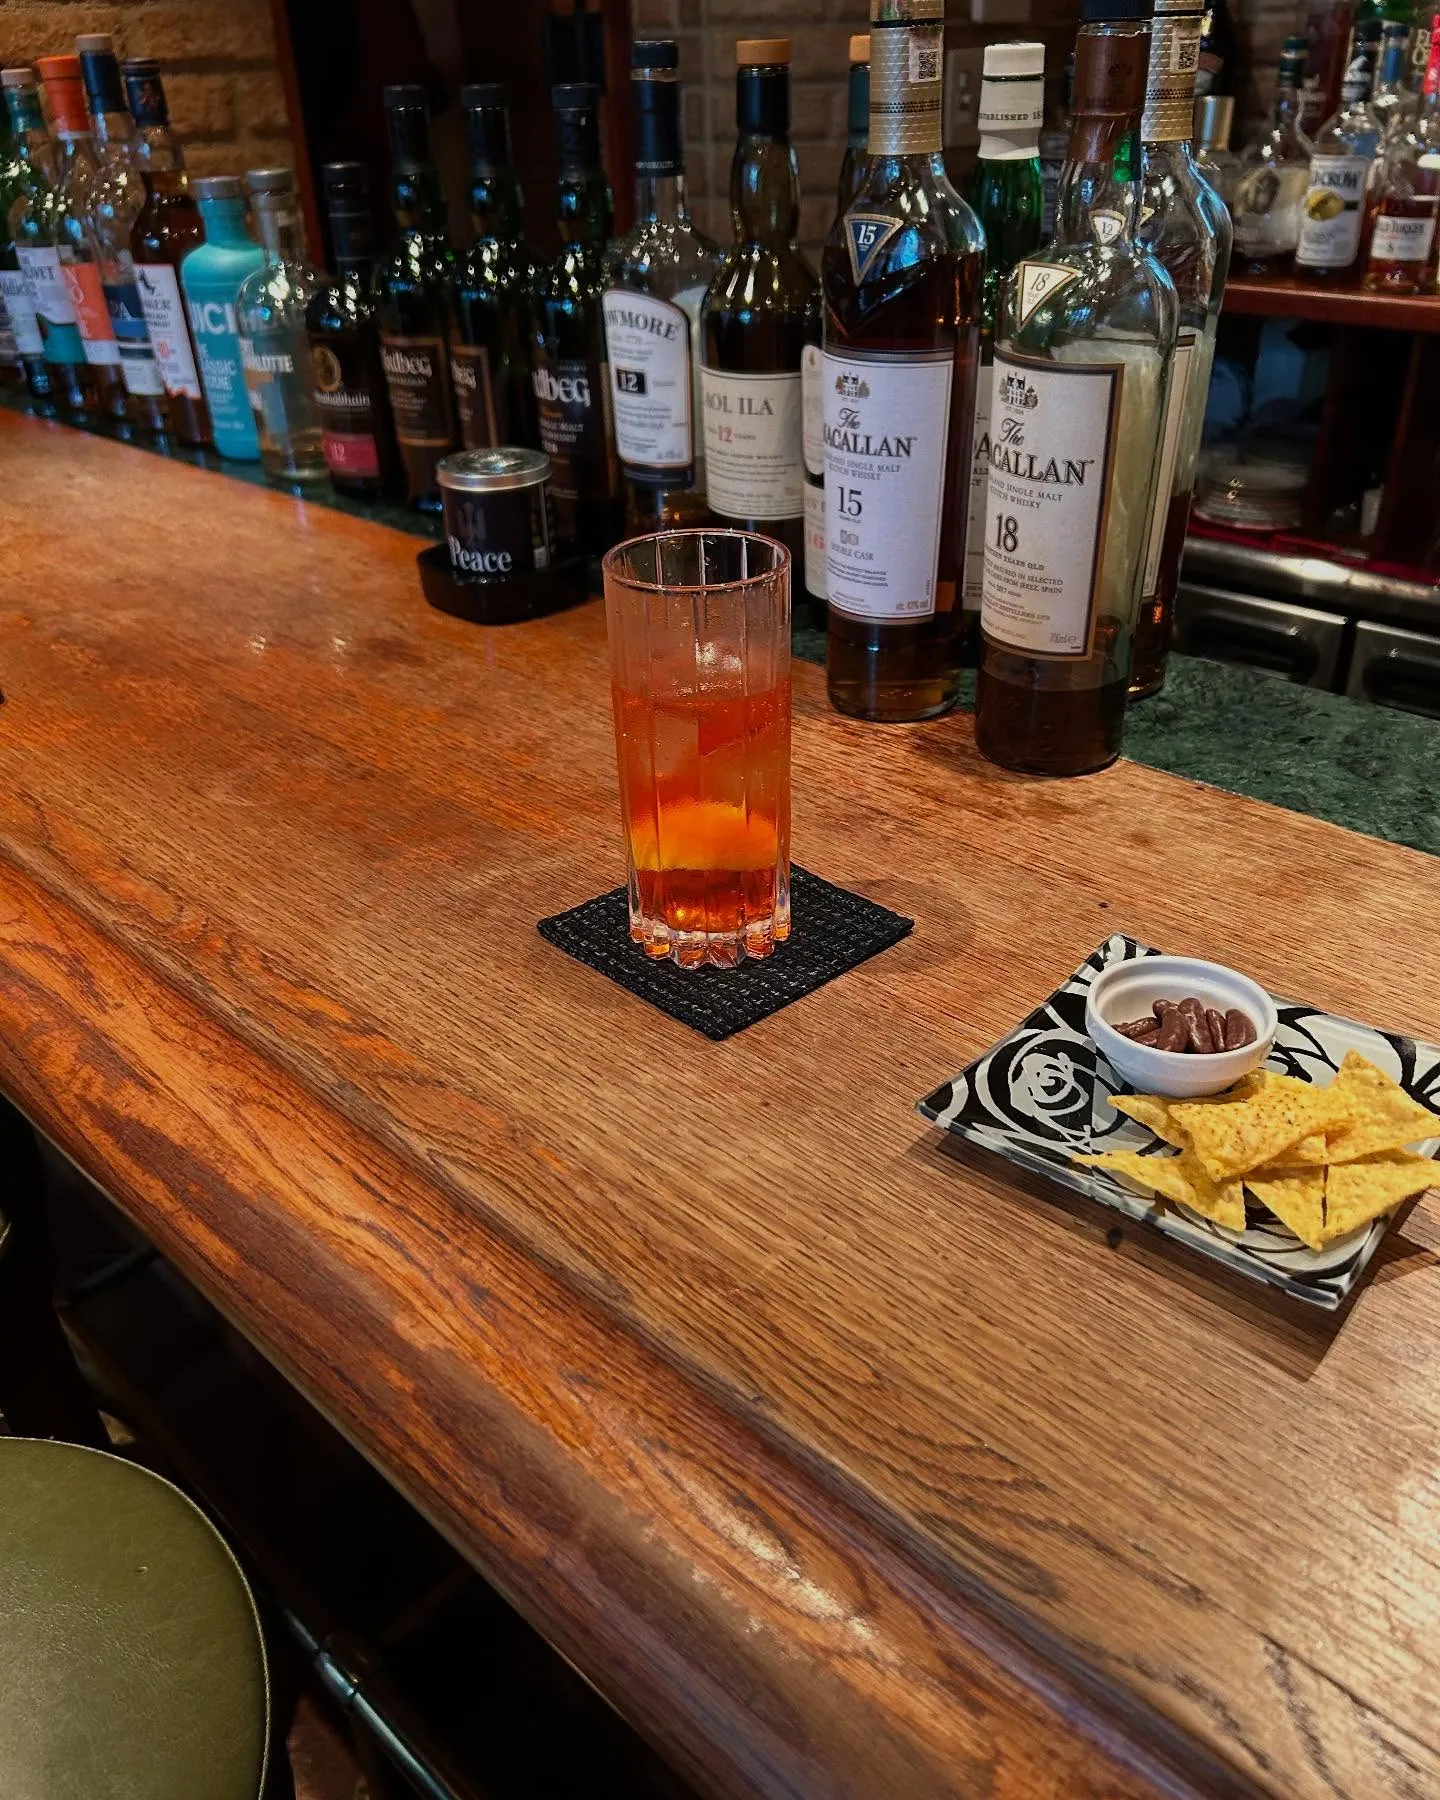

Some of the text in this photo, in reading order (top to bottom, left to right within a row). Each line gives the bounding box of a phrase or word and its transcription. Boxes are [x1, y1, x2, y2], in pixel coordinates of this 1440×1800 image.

[857, 224, 877, 245] 15
[1101, 221, 1114, 235] 12
[1030, 272, 1050, 292] 18
[618, 371, 639, 392] 12
[737, 395, 775, 416] ILA
[838, 407, 862, 430] The
[718, 424, 733, 443] 12
[999, 417, 1026, 447] The
[851, 469, 881, 481] WHISKY
[877, 463, 901, 474] MALT
[837, 486, 862, 517] 15
[1006, 481, 1034, 498] SINGLE
[1038, 489, 1063, 502] MALT
[1010, 494, 1042, 509] WHISKY
[996, 513, 1018, 553] 18
[448, 535, 513, 573] Peace
[854, 550, 875, 561] CASK
[1027, 562, 1045, 571] OLD
[1027, 575, 1064, 586] SELECTED
[1041, 586, 1063, 595] SPAIN
